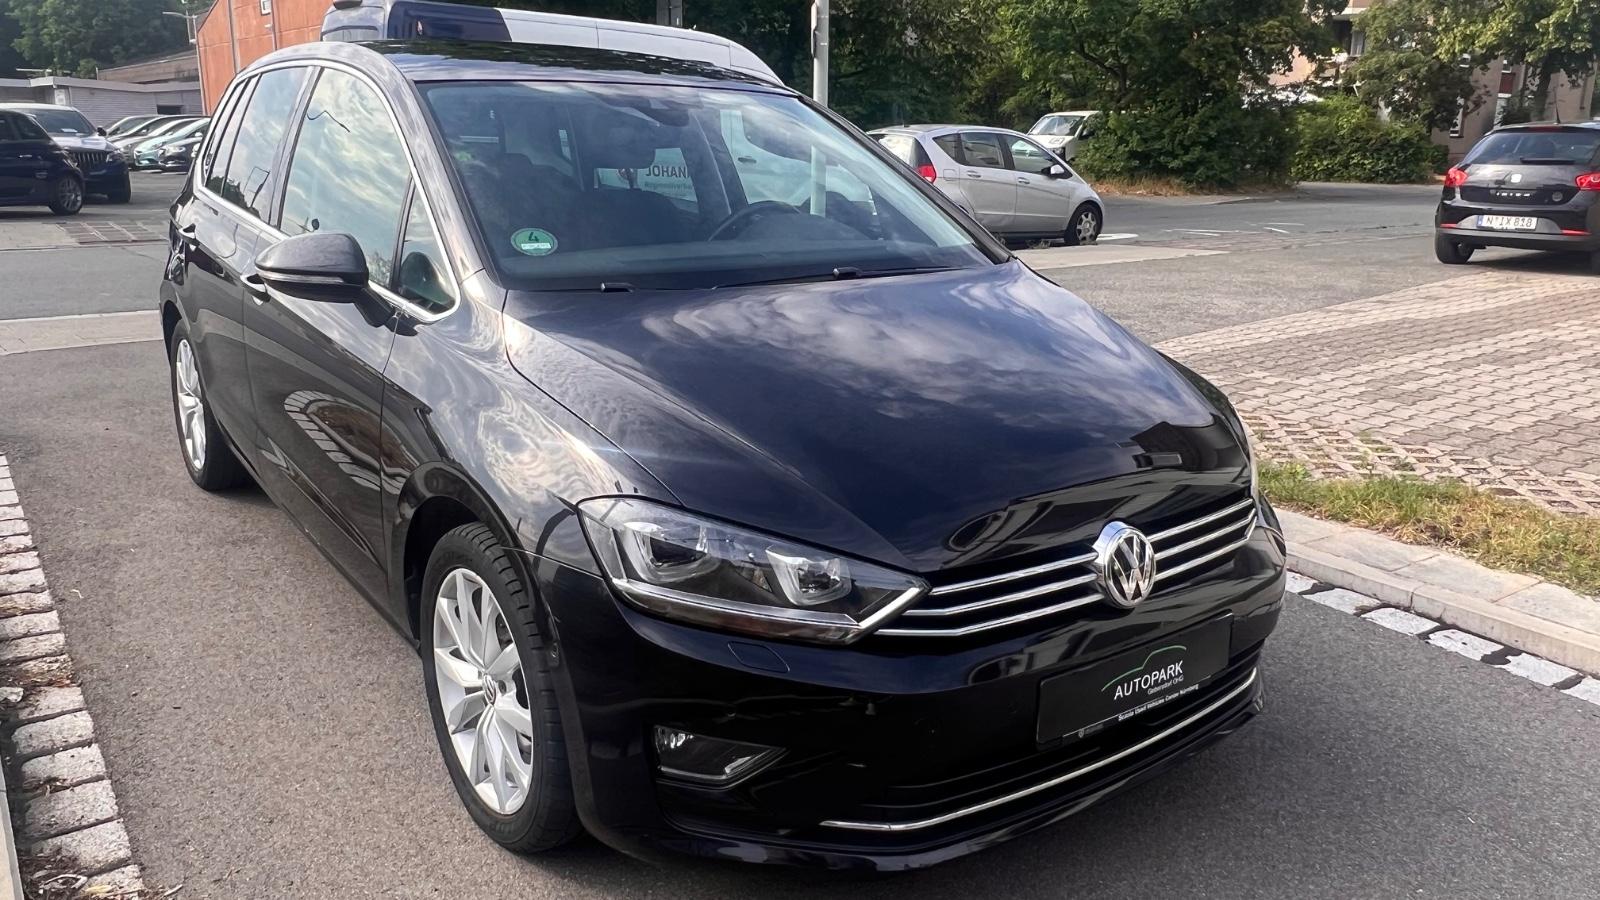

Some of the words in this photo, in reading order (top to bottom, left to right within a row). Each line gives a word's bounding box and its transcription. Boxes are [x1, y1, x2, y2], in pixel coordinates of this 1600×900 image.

[1486, 216, 1494, 225] N
[528, 231, 539, 242] 4
[1114, 660, 1184, 701] AUTOPARK
